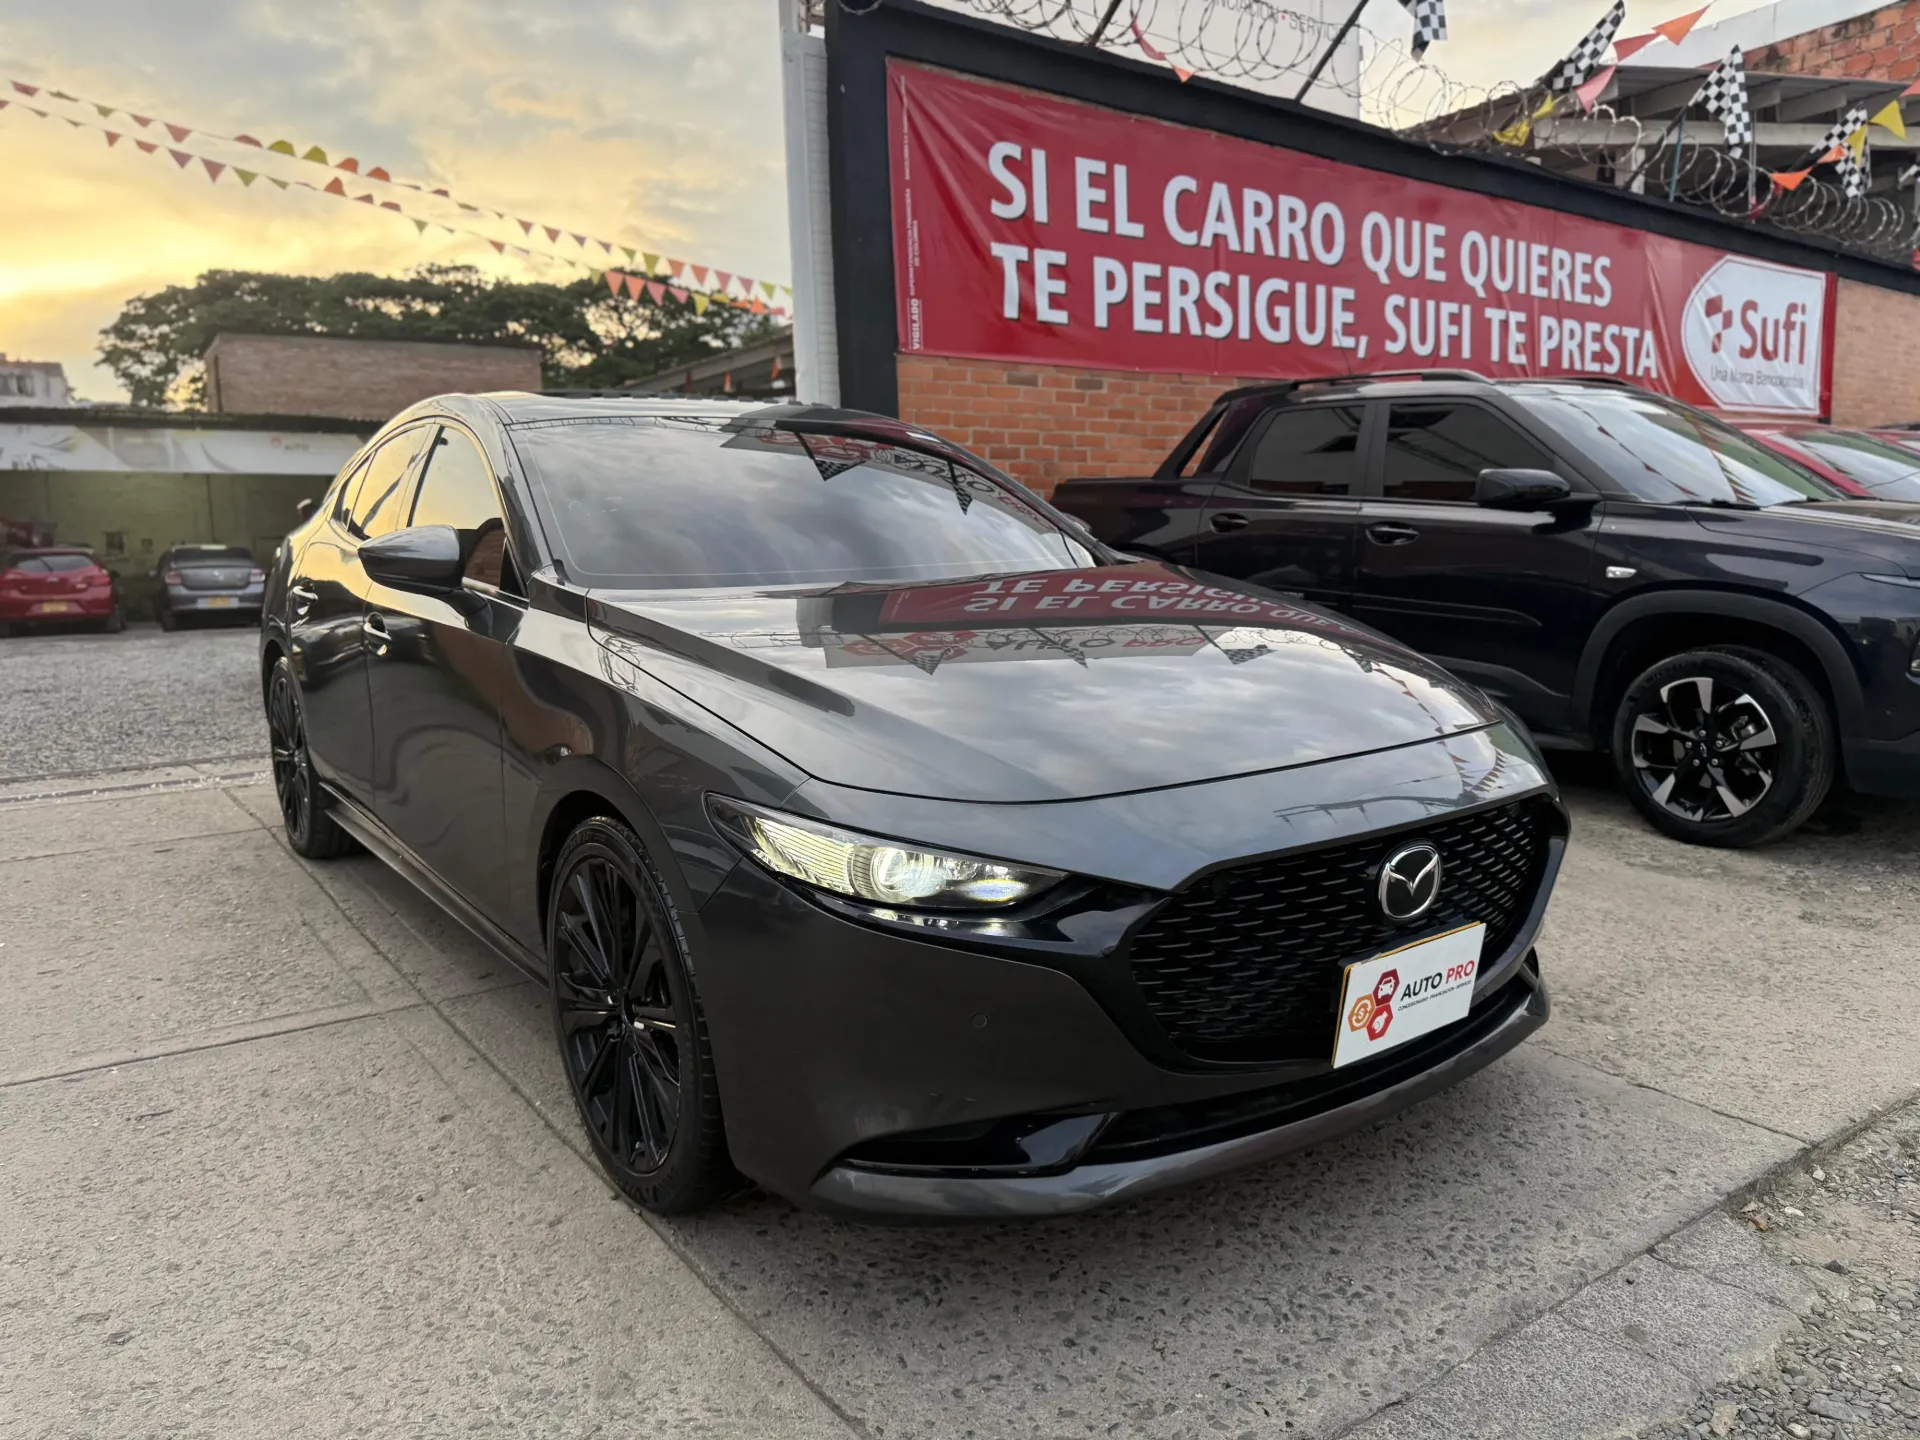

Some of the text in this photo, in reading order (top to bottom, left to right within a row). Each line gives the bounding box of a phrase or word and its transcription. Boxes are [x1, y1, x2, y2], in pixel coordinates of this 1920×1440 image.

[988, 141, 1612, 308] SI EL CARRO QUE QUIERES
[910, 298, 920, 350] VIGILADO
[990, 242, 1658, 379] TE PERSIGUE, SUFI TE PRESTA
[1738, 299, 1806, 365] Sufi
[1400, 960, 1475, 1001] AUTO PRO
